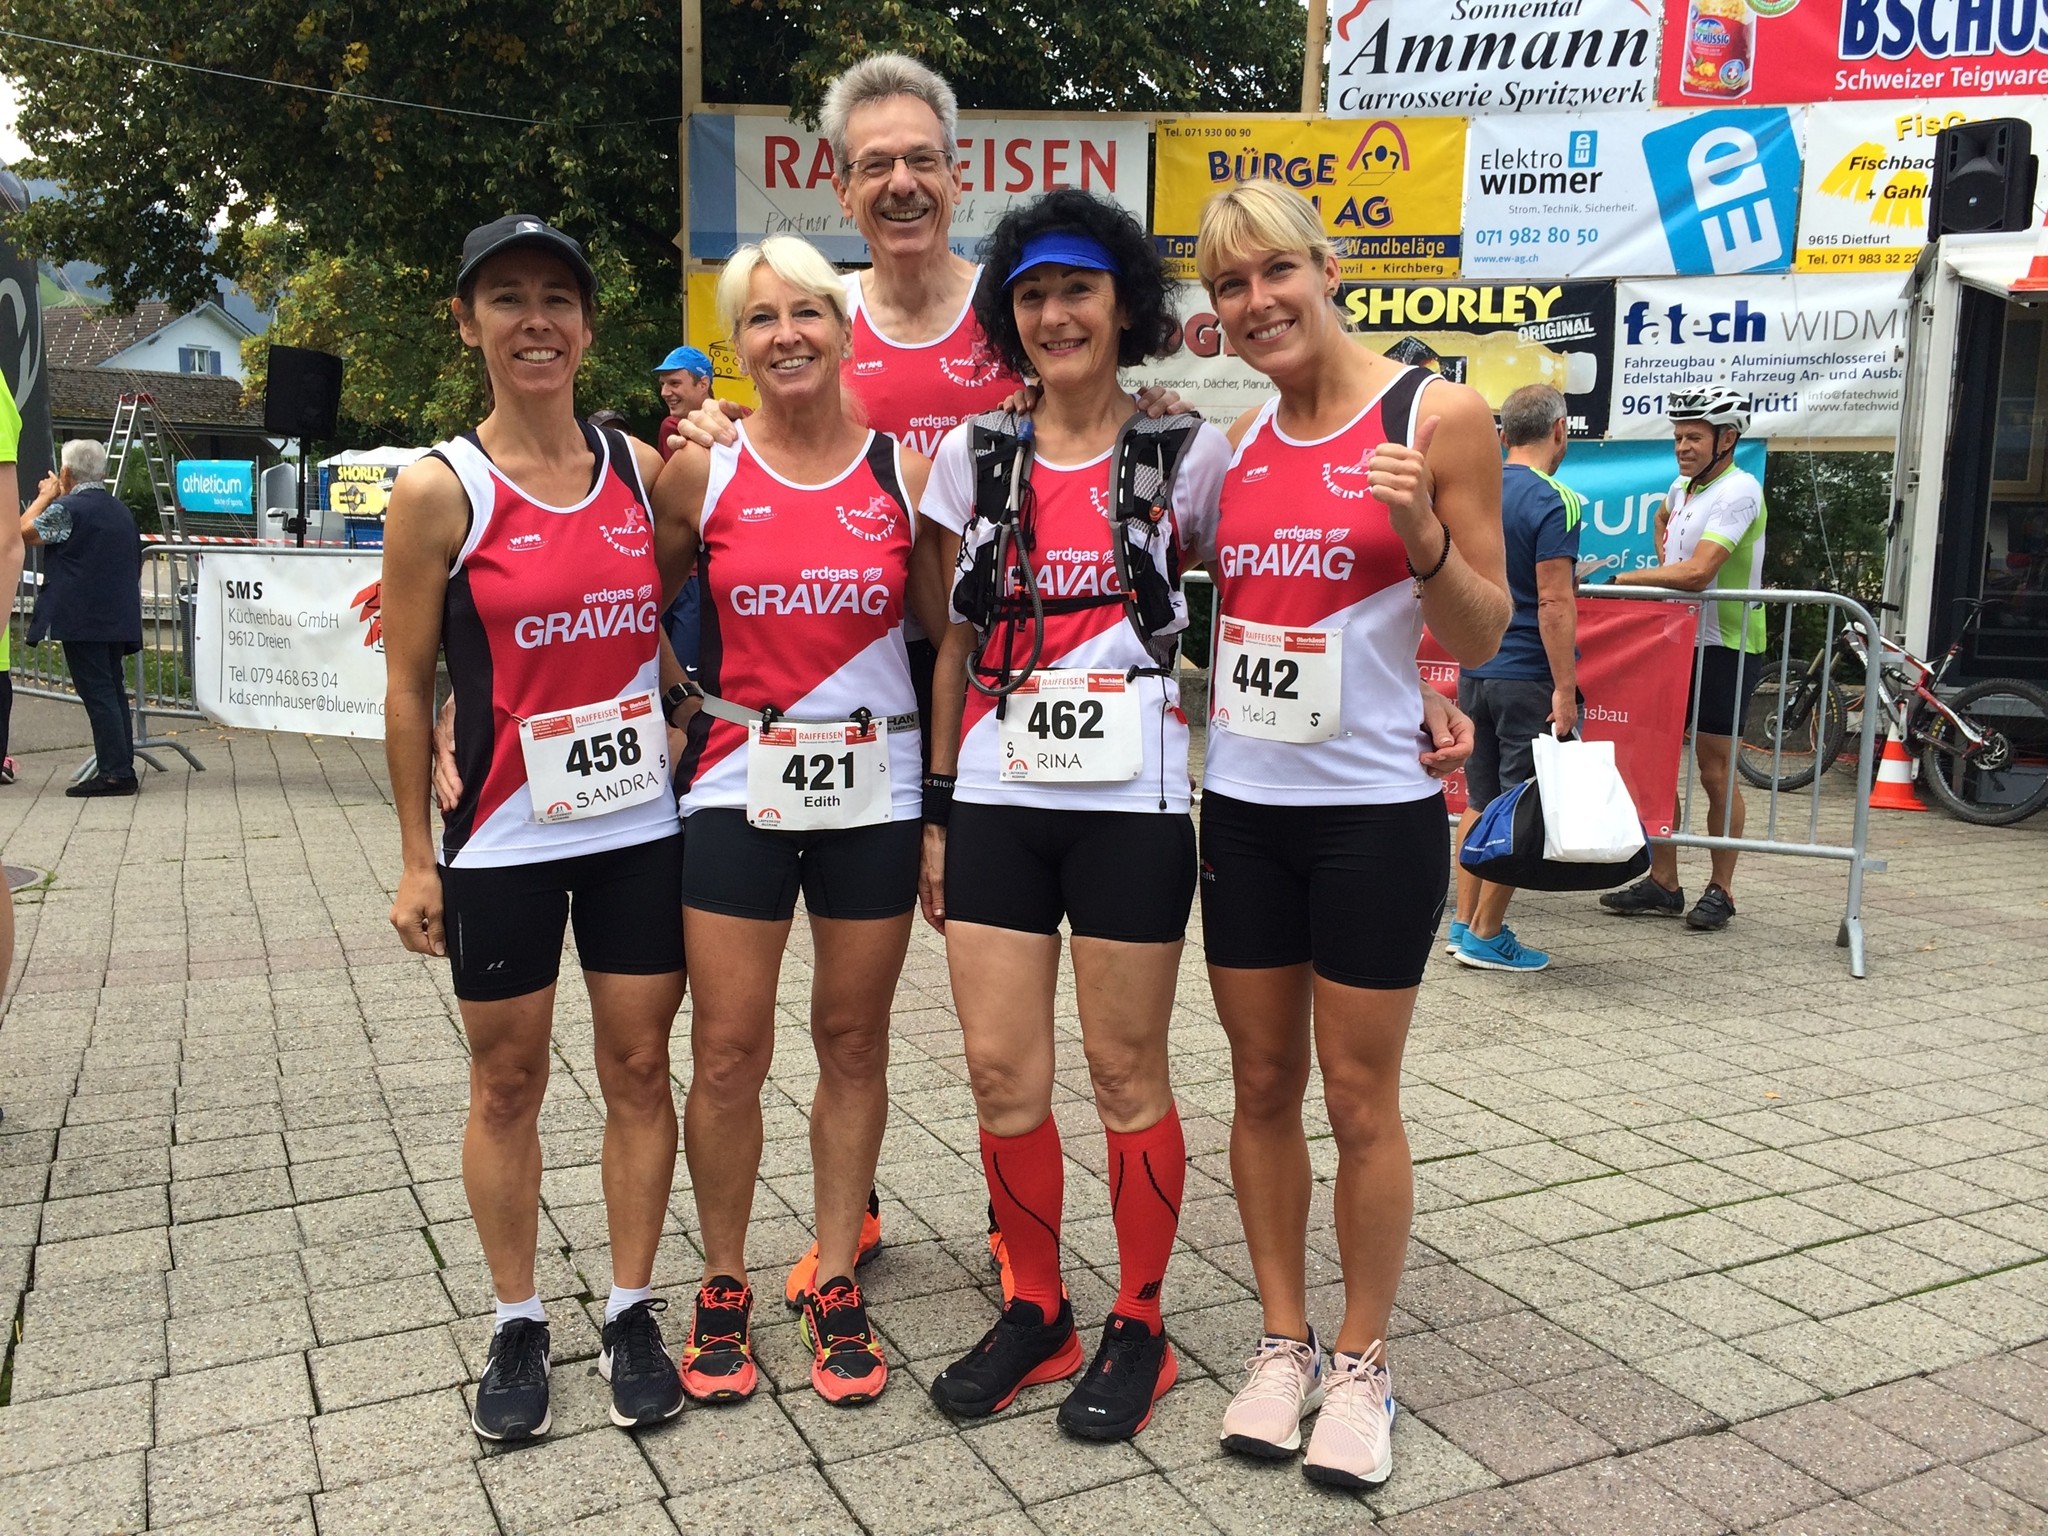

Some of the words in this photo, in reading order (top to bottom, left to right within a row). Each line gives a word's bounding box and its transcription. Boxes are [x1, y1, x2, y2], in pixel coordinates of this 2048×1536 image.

[1338, 17, 1650, 77] Ammann
[1834, 67, 1943, 91] Schweizer
[1338, 82, 1493, 111] Carrosserie
[1499, 79, 1647, 112] Spritzwerk
[1165, 127, 1182, 137] Tel.
[1185, 127, 1202, 138] 071
[1204, 128, 1222, 138] 930
[1225, 128, 1237, 138] 00
[1239, 128, 1252, 138] 90
[1208, 147, 1339, 189] BÜRGE
[1481, 148, 1563, 170] Elektro
[1333, 194, 1394, 229] AG
[1508, 204, 1541, 215] Strom.
[1543, 203, 1582, 214] Technik.
[1585, 203, 1638, 213] Sicherheit.
[765, 211, 832, 234] Partner
[1475, 229, 1502, 246] 071
[1509, 227, 1541, 246] 982
[1547, 226, 1571, 244] 80
[1577, 227, 1599, 246] 50
[1808, 235, 1838, 246] 9615
[1842, 234, 1891, 245] Dietfurt
[1346, 237, 1446, 259] Wandbeläge
[1383, 263, 1444, 274] Kirchberg
[1473, 253, 1540, 265] www.ew-ag.ch
[1807, 254, 1828, 265] Tel.
[1832, 254, 1854, 264] 071
[1858, 254, 1882, 264] 983
[1885, 254, 1901, 264] 32
[1345, 285, 1563, 326] SHORLEY
[1518, 317, 1595, 343] ORIGINAL
[1780, 308, 1908, 341] WIDM
[1624, 356, 1715, 369] Fahrzeugbau
[1731, 350, 1887, 367] Aluminiumschlosserei
[1204, 378, 1240, 390] Dächer,
[1623, 371, 1713, 384] Edelstahlbau
[1731, 370, 1795, 384] Fahrzeug
[1800, 369, 1825, 381] An-
[1829, 367, 1857, 380] und
[1622, 394, 1668, 415] 961
[909, 413, 958, 429] erdgas
[182, 473, 242, 495] athleticum
[337, 466, 387, 482] SHORLEY
[835, 505, 898, 542] RHEINTAL
[1274, 525, 1323, 543] erdgas
[1046, 547, 1099, 563] erdgas
[1220, 543, 1356, 581] GRAVAG
[800, 566, 859, 582] erdgas
[226, 580, 263, 600] SMS
[583, 588, 634, 604] erdgas
[730, 583, 890, 616] GRAVAG
[228, 608, 292, 627] Küchenbau
[297, 611, 340, 629] GmbH
[514, 601, 658, 649] GRAVAG
[228, 630, 255, 647] 9612
[257, 633, 292, 650] Dreien
[1245, 631, 1282, 643] RAIFFEISEN
[229, 665, 248, 682] Tel.
[250, 667, 274, 684] 079
[321, 672, 338, 688] 04
[1042, 677, 1085, 686] RAIFFEISEN
[1232, 653, 1299, 700] 442
[575, 707, 619, 725] RAIFFEISEN
[1028, 700, 1104, 740] 462
[1310, 712, 1321, 727] S
[799, 731, 843, 741] RAIFFEISEN
[565, 726, 642, 777] 458
[1037, 753, 1083, 769] RINA
[782, 751, 855, 791] 421
[576, 770, 659, 809] SANDRA
[804, 795, 841, 808] Edith
